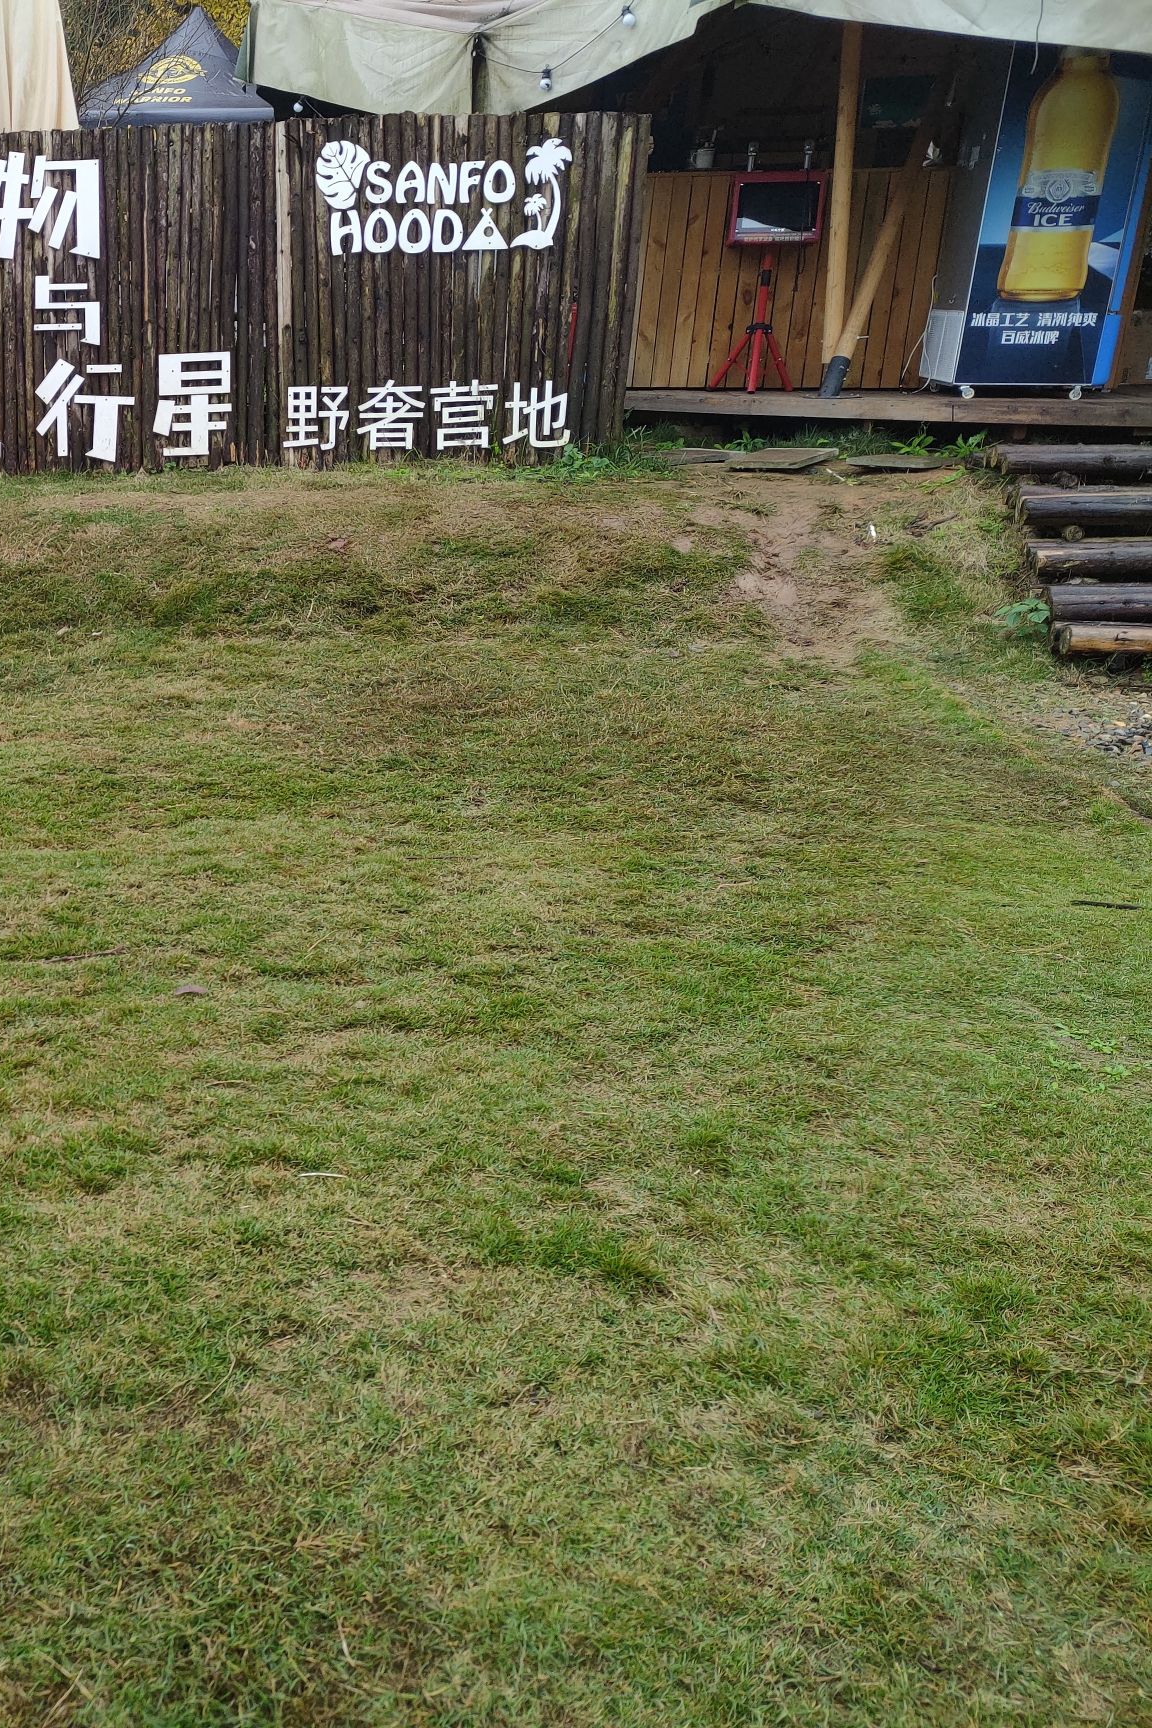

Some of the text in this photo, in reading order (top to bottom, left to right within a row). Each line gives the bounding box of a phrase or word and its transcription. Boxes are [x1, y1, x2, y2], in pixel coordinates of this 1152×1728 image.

[365, 160, 516, 205] SANFO
[1028, 201, 1085, 214] Budweiser
[1033, 213, 1073, 227] ICE
[34, 275, 101, 346] 与
[971, 312, 1030, 327] 冰晶工艺
[1001, 330, 1059, 345] 百威冰啤
[35, 351, 232, 463] 行星
[283, 379, 570, 451] 野奢营地
